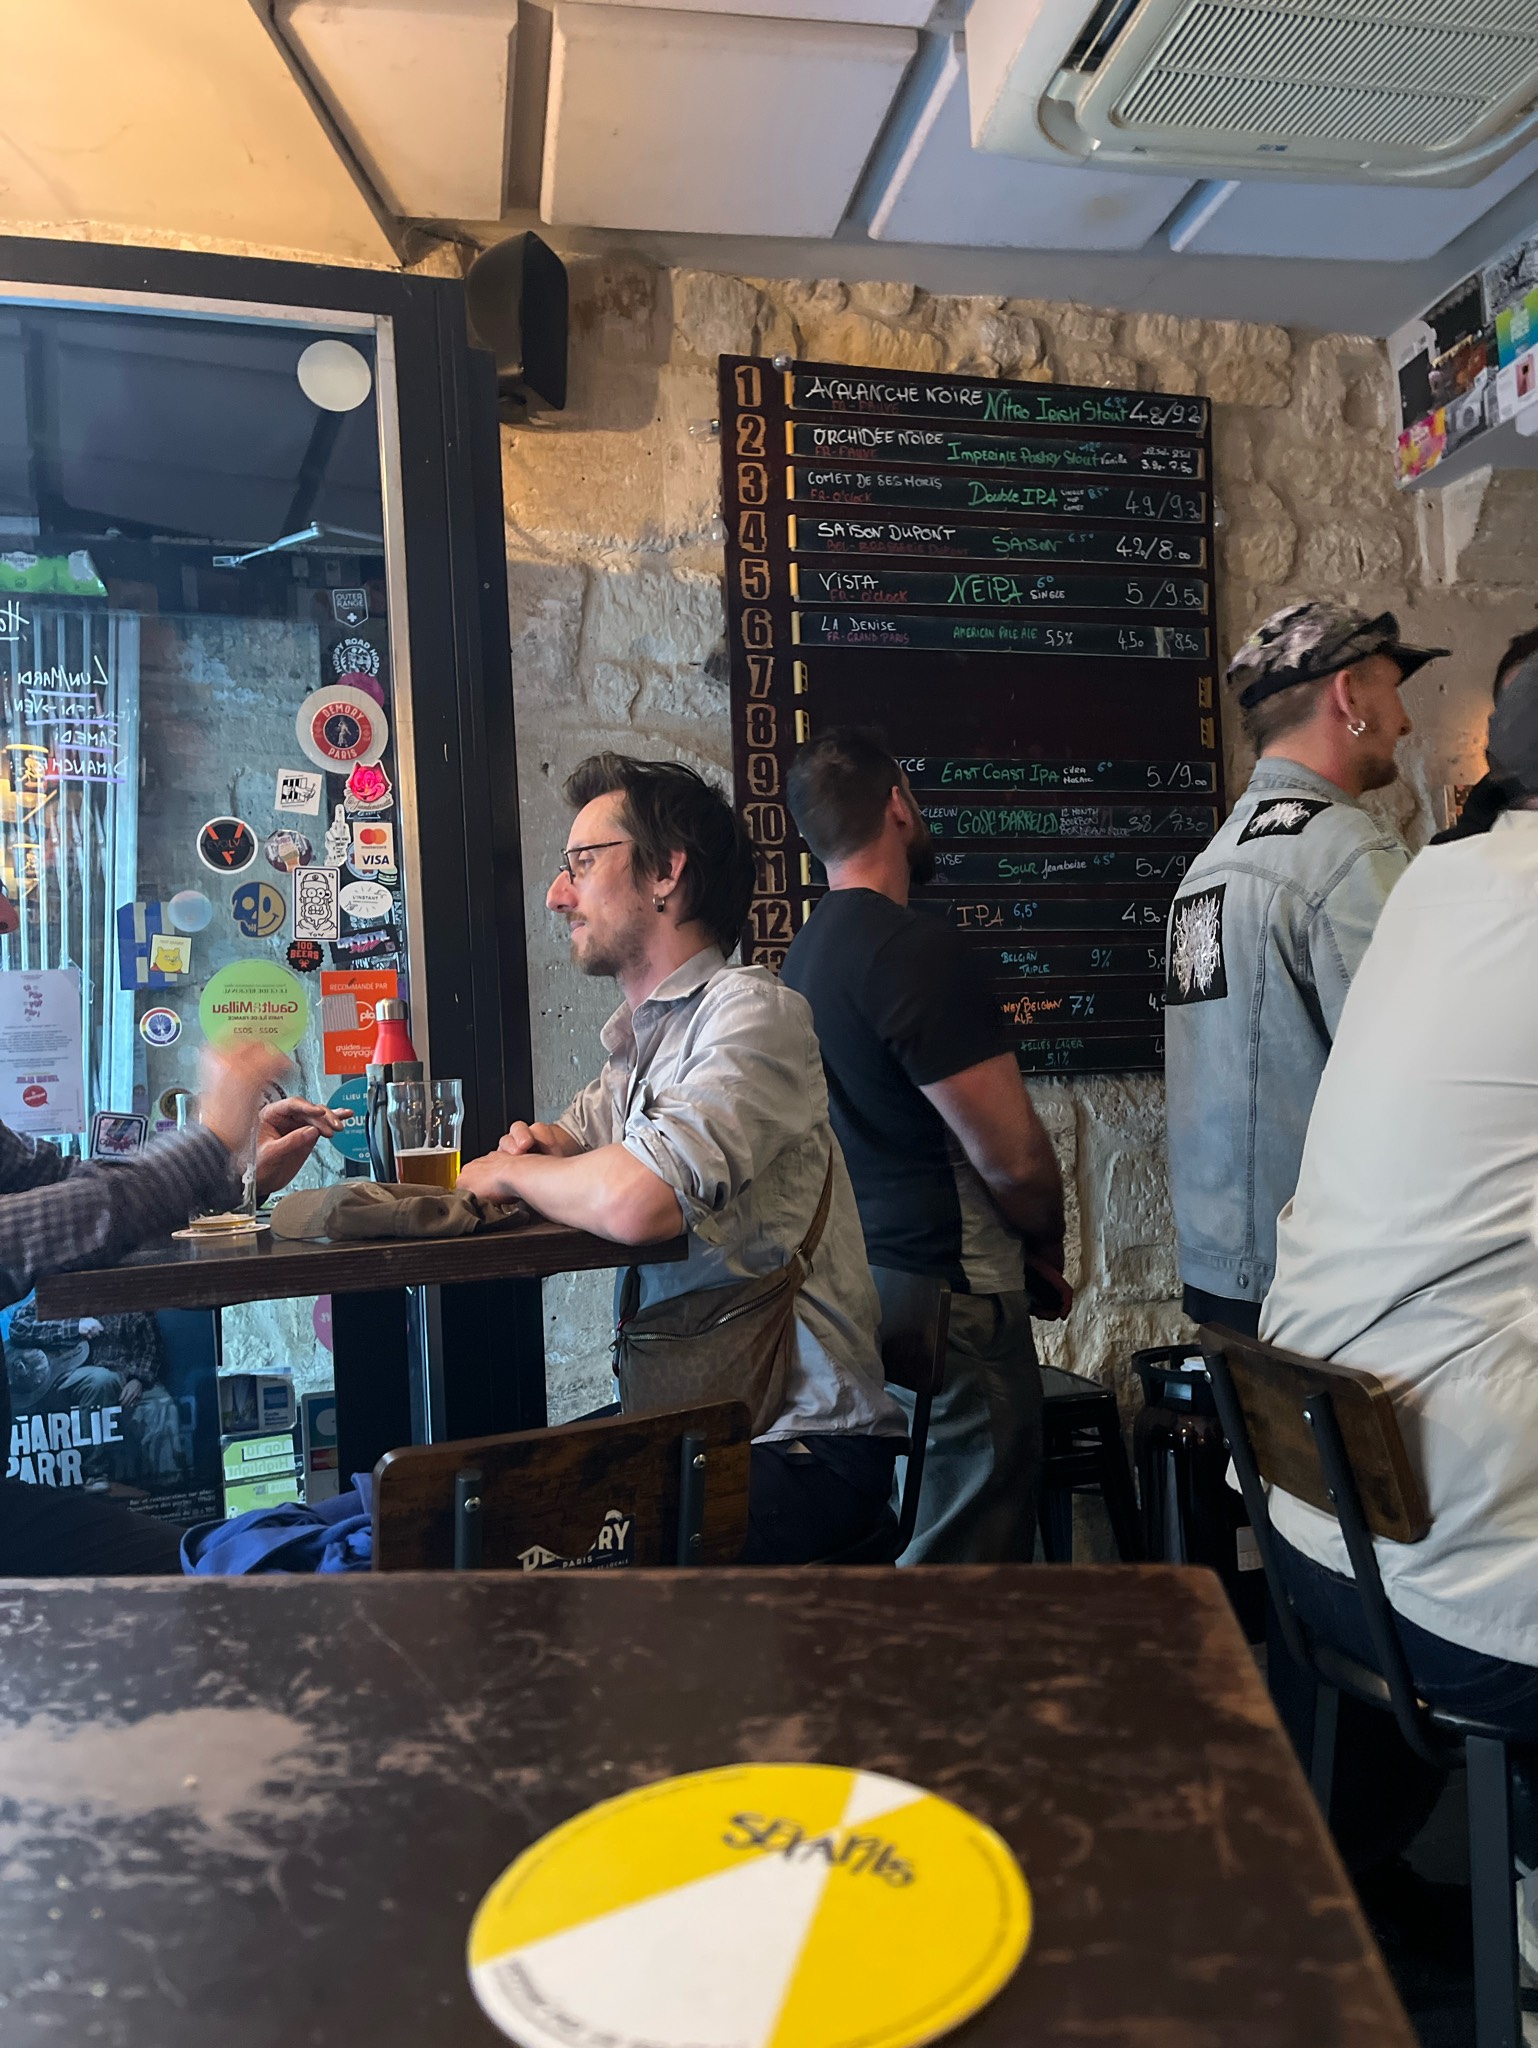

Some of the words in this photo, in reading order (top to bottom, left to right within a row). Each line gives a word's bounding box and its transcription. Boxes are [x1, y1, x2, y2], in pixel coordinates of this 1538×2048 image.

[735, 365, 761, 407] 1
[805, 376, 919, 402] AVALANCHE
[926, 388, 983, 405] NOIRE
[1082, 400, 1128, 423] Stout
[736, 414, 766, 456] 2
[899, 431, 944, 446] NOIRE
[737, 462, 768, 505] 3
[808, 471, 852, 485] COMET
[856, 473, 872, 488] DE
[878, 475, 903, 487] SES
[968, 480, 1019, 506] Double
[1021, 487, 1058, 507] IPA
[738, 511, 767, 552] 4
[818, 522, 884, 539] SAISON
[890, 524, 956, 542] DUPONT
[740, 558, 770, 600] 5
[819, 572, 879, 591] VISTA
[336, 600, 364, 609] RANGE
[741, 608, 773, 649] 6
[821, 616, 838, 631] LA
[850, 617, 896, 632] DENISE
[953, 627, 995, 639] AMERICAN
[999, 628, 1019, 640] PALE
[1020, 628, 1038, 640] ALE
[879, 632, 910, 645] PARIS
[332, 642, 344, 674] HOPPY
[344, 637, 371, 650] ROAD
[369, 648, 380, 677] HOPP
[746, 654, 775, 698] 7
[322, 704, 366, 720] DEMORY
[746, 703, 777, 748] 8
[327, 748, 358, 760] PARIS
[747, 752, 780, 796] 9
[744, 802, 786, 845] 10
[957, 810, 997, 835] GOSE
[998, 809, 1060, 834] BARRELED
[362, 854, 390, 865] VISA
[748, 900, 794, 942] 12
[956, 905, 1004, 927] IPA
[290, 950, 319, 959] BEERS
[296, 941, 314, 950] 100
[1001, 951, 1038, 964] BELGIAN
[1091, 949, 1113, 967] 9%
[1019, 963, 1050, 974] TRIPLE
[375, 982, 388, 990] PAR
[1069, 993, 1095, 1016] 7%
[1014, 1012, 1033, 1024] ALE
[336, 1044, 361, 1053] guides
[1055, 1039, 1084, 1050] LAGER
[10, 1404, 124, 1456] HARLIE
[562, 1555, 593, 1569] PARIS
